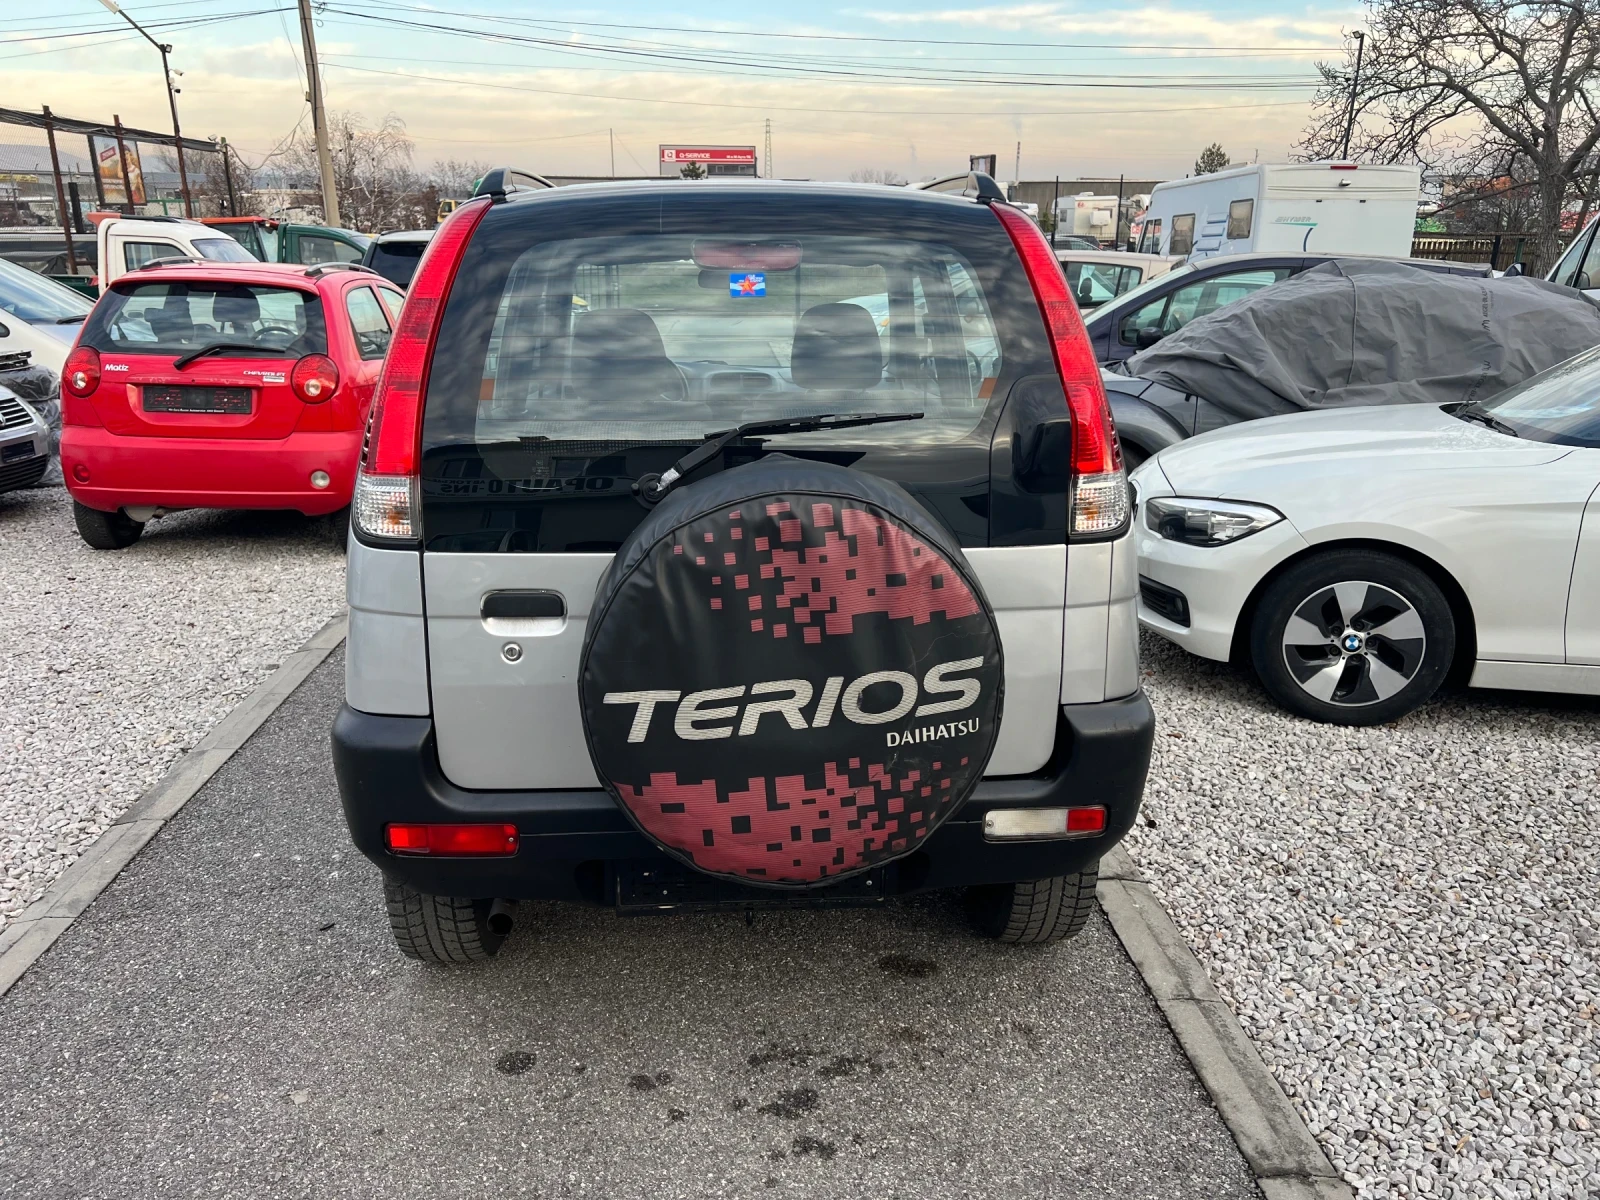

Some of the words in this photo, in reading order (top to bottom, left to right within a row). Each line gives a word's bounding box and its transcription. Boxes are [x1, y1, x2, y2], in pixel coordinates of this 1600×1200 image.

[104, 363, 129, 372] Matiz
[603, 655, 984, 743] TERIOS
[886, 718, 979, 747] DAIHATSU
